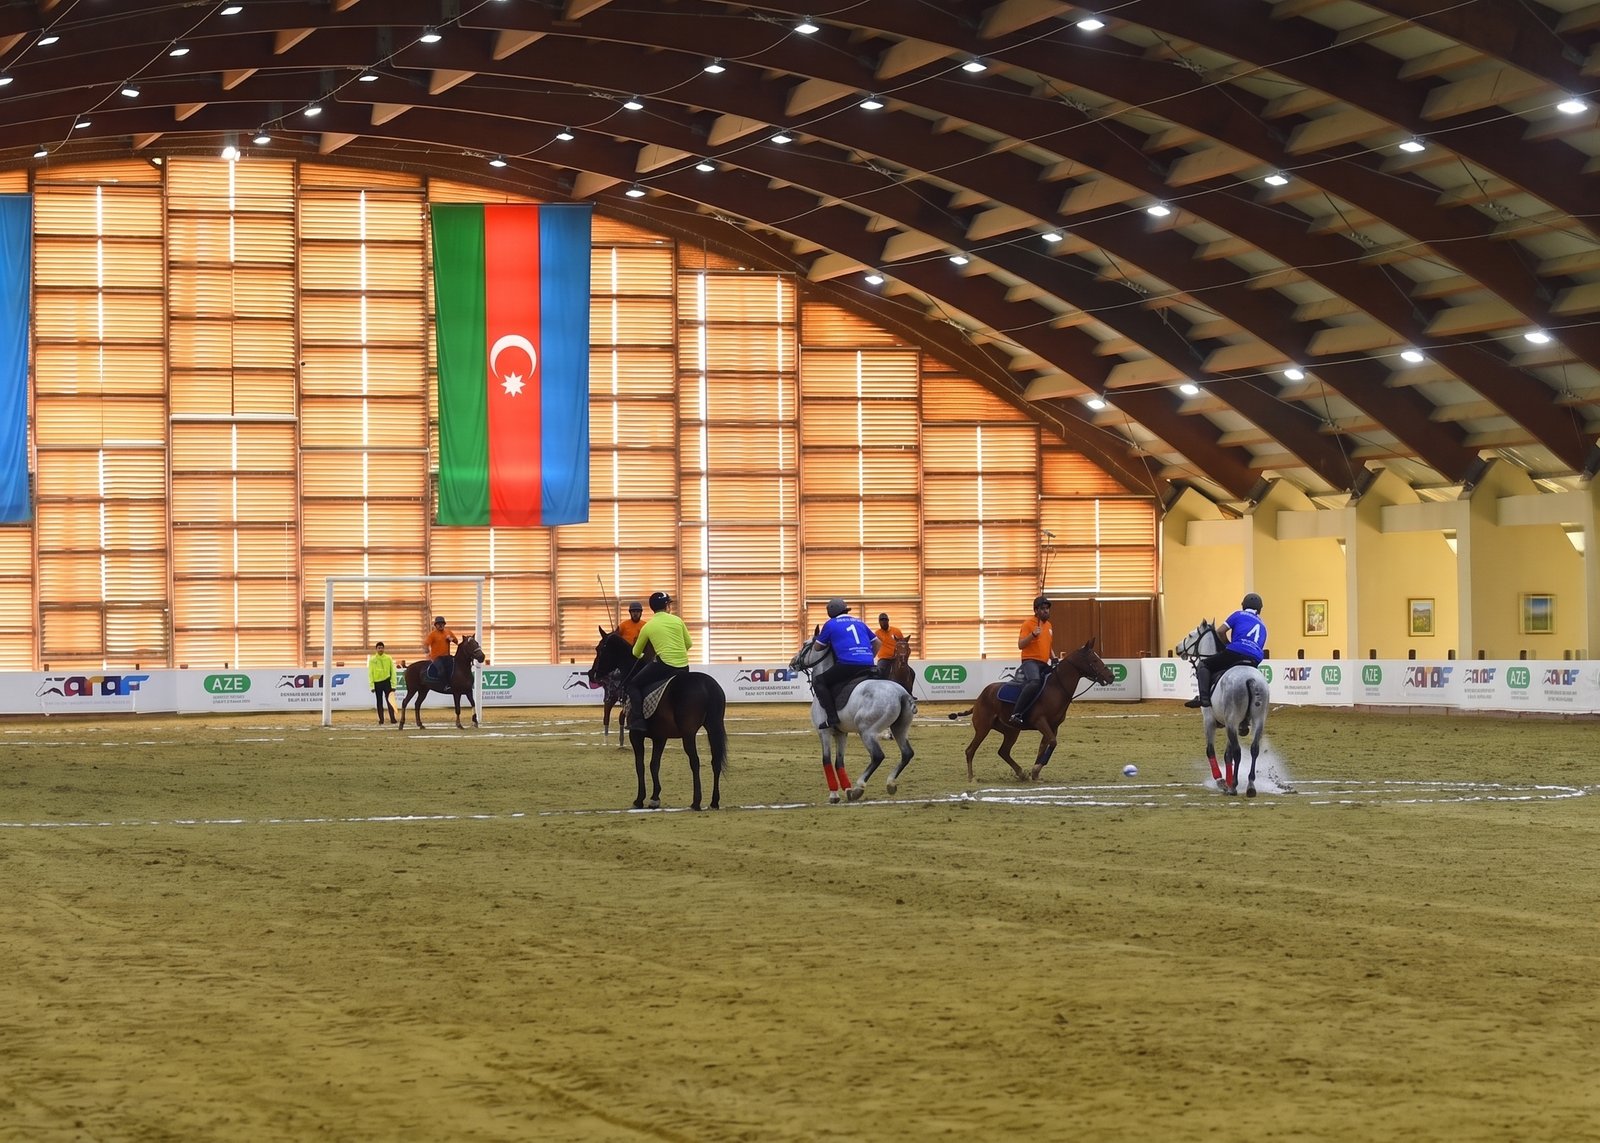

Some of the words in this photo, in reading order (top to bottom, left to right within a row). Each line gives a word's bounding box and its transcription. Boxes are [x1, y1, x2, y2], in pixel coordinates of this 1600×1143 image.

[846, 624, 860, 645] 1
[1246, 623, 1260, 643] 1
[931, 668, 960, 681] AZE
[1162, 666, 1175, 679] AZE
[1324, 669, 1338, 682] AZE
[1365, 668, 1378, 682] AZE
[1510, 671, 1527, 685] AZE
[212, 678, 243, 691] AZE
[481, 674, 508, 686] AZE
